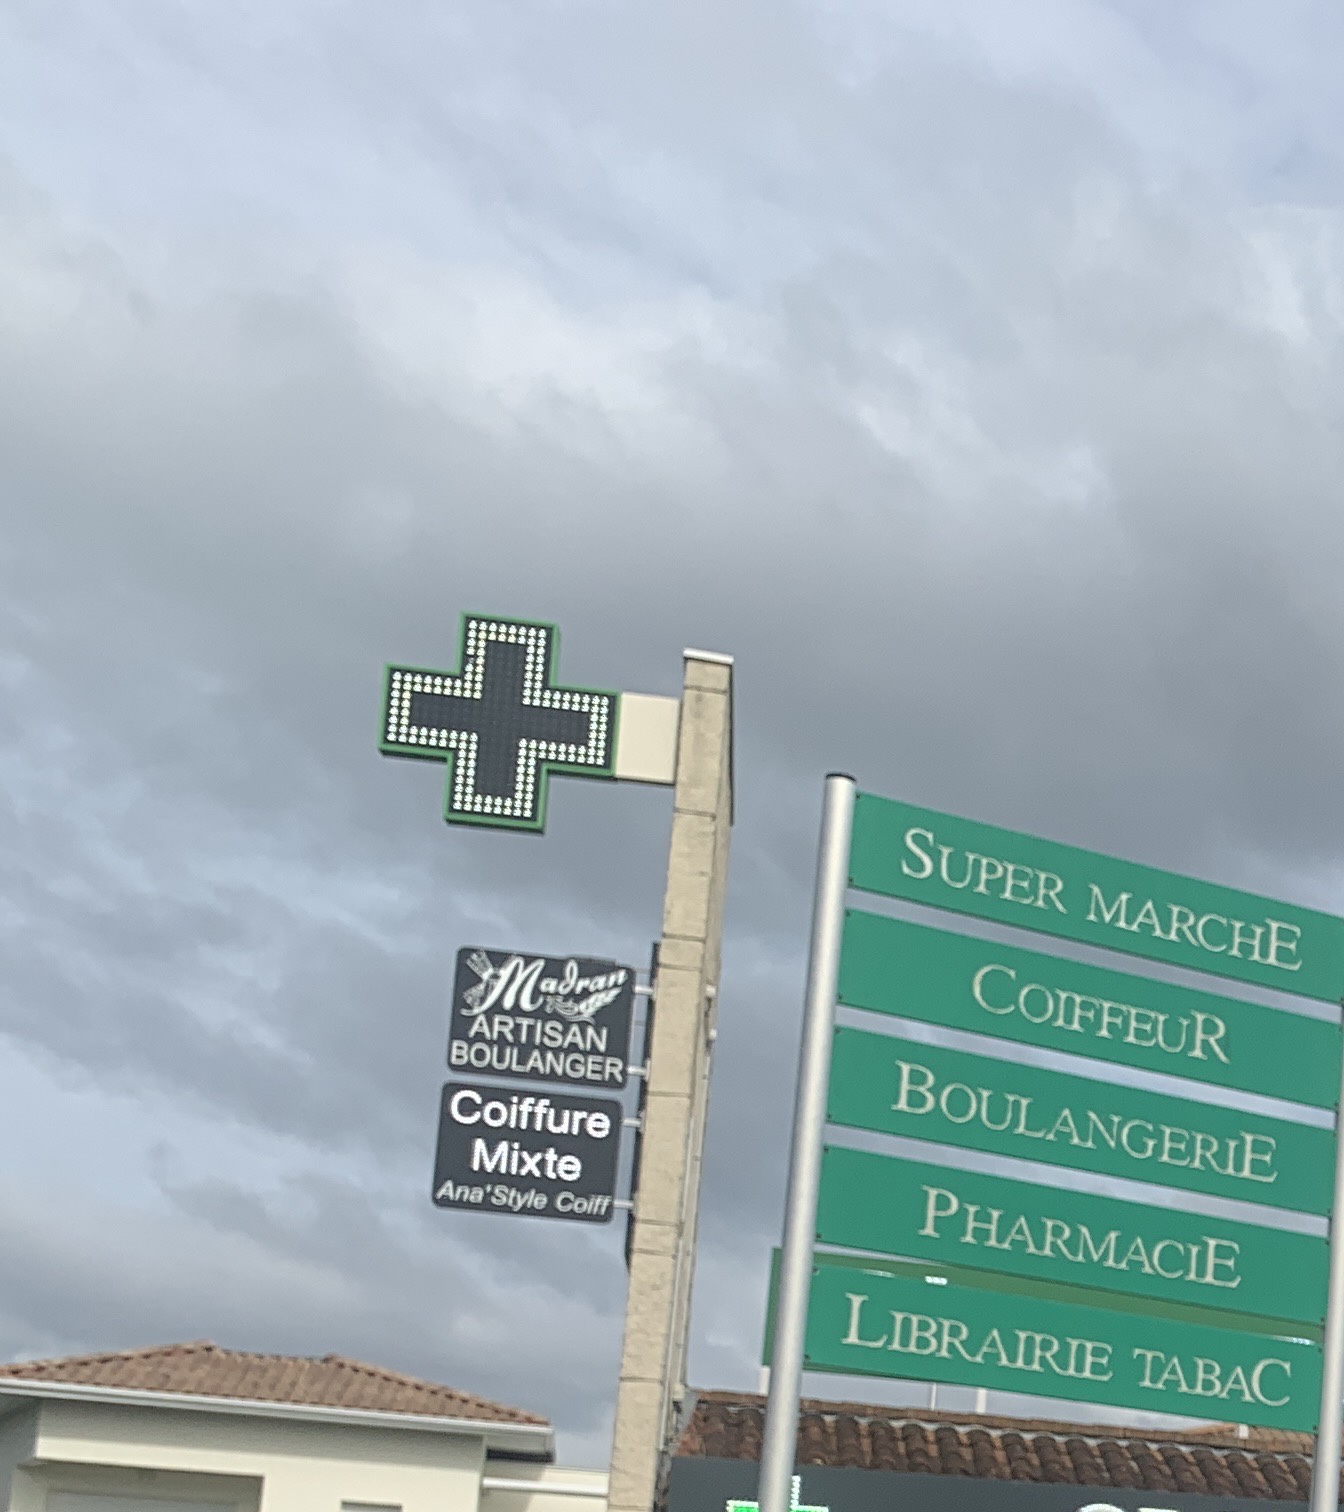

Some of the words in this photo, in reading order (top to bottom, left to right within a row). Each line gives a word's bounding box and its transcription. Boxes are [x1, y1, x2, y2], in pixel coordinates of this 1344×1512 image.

[901, 827, 1067, 916] SUPER
[1086, 882, 1303, 972] MARCHE
[460, 956, 628, 1017] Madran
[971, 963, 1230, 1065] COIFFEUR
[450, 1039, 624, 1084] BOULANGER
[468, 1014, 608, 1053] ARTISAN
[450, 1090, 612, 1139] Coiffure
[892, 1060, 1278, 1183] BOULANGERIE
[470, 1138, 583, 1182] Mixte
[436, 1179, 549, 1213] Ana'Style
[556, 1191, 613, 1217] Coiff
[919, 1185, 1242, 1288] PHARMACIE
[842, 1294, 1114, 1383] LIBRAIRIE
[1132, 1349, 1292, 1408] TABAC
